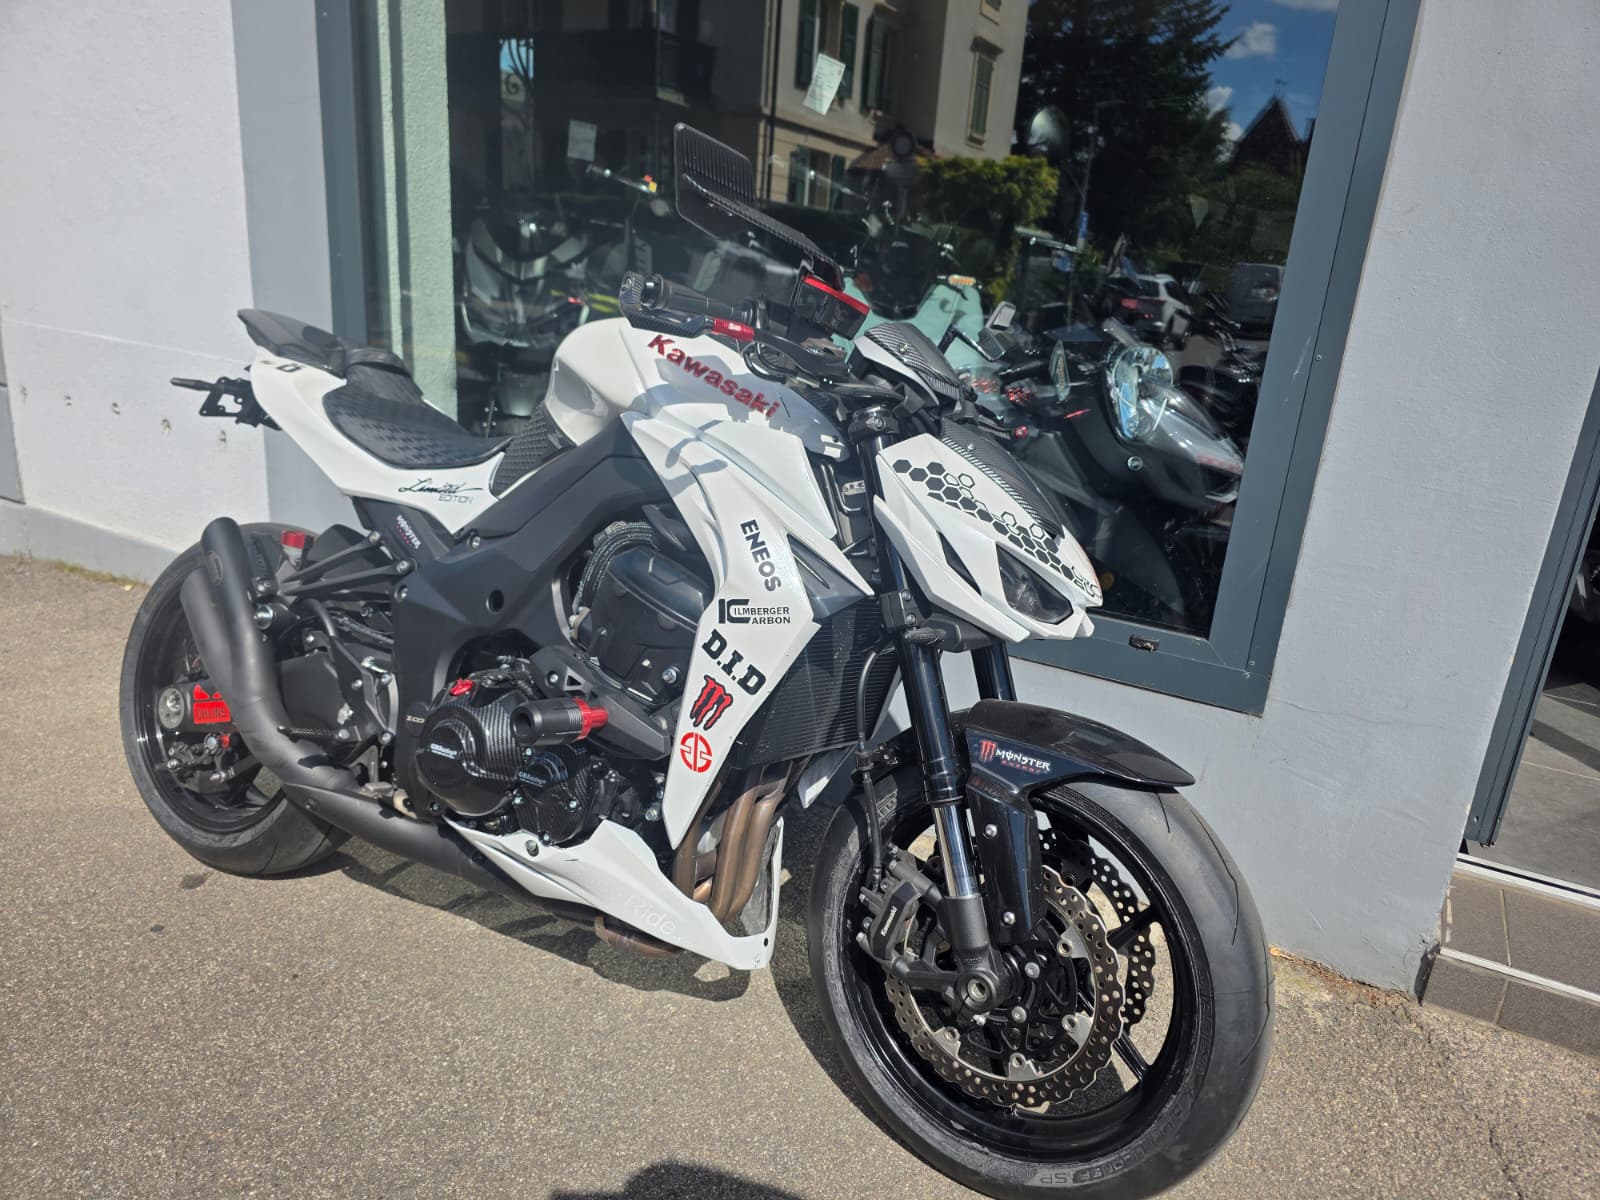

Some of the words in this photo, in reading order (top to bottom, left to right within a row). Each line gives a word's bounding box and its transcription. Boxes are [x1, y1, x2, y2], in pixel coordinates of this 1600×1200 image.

[648, 334, 780, 417] Kawasaki
[740, 519, 782, 592] ENEOS
[701, 628, 767, 696] D.I.D
[995, 748, 1052, 772] MONSTER
